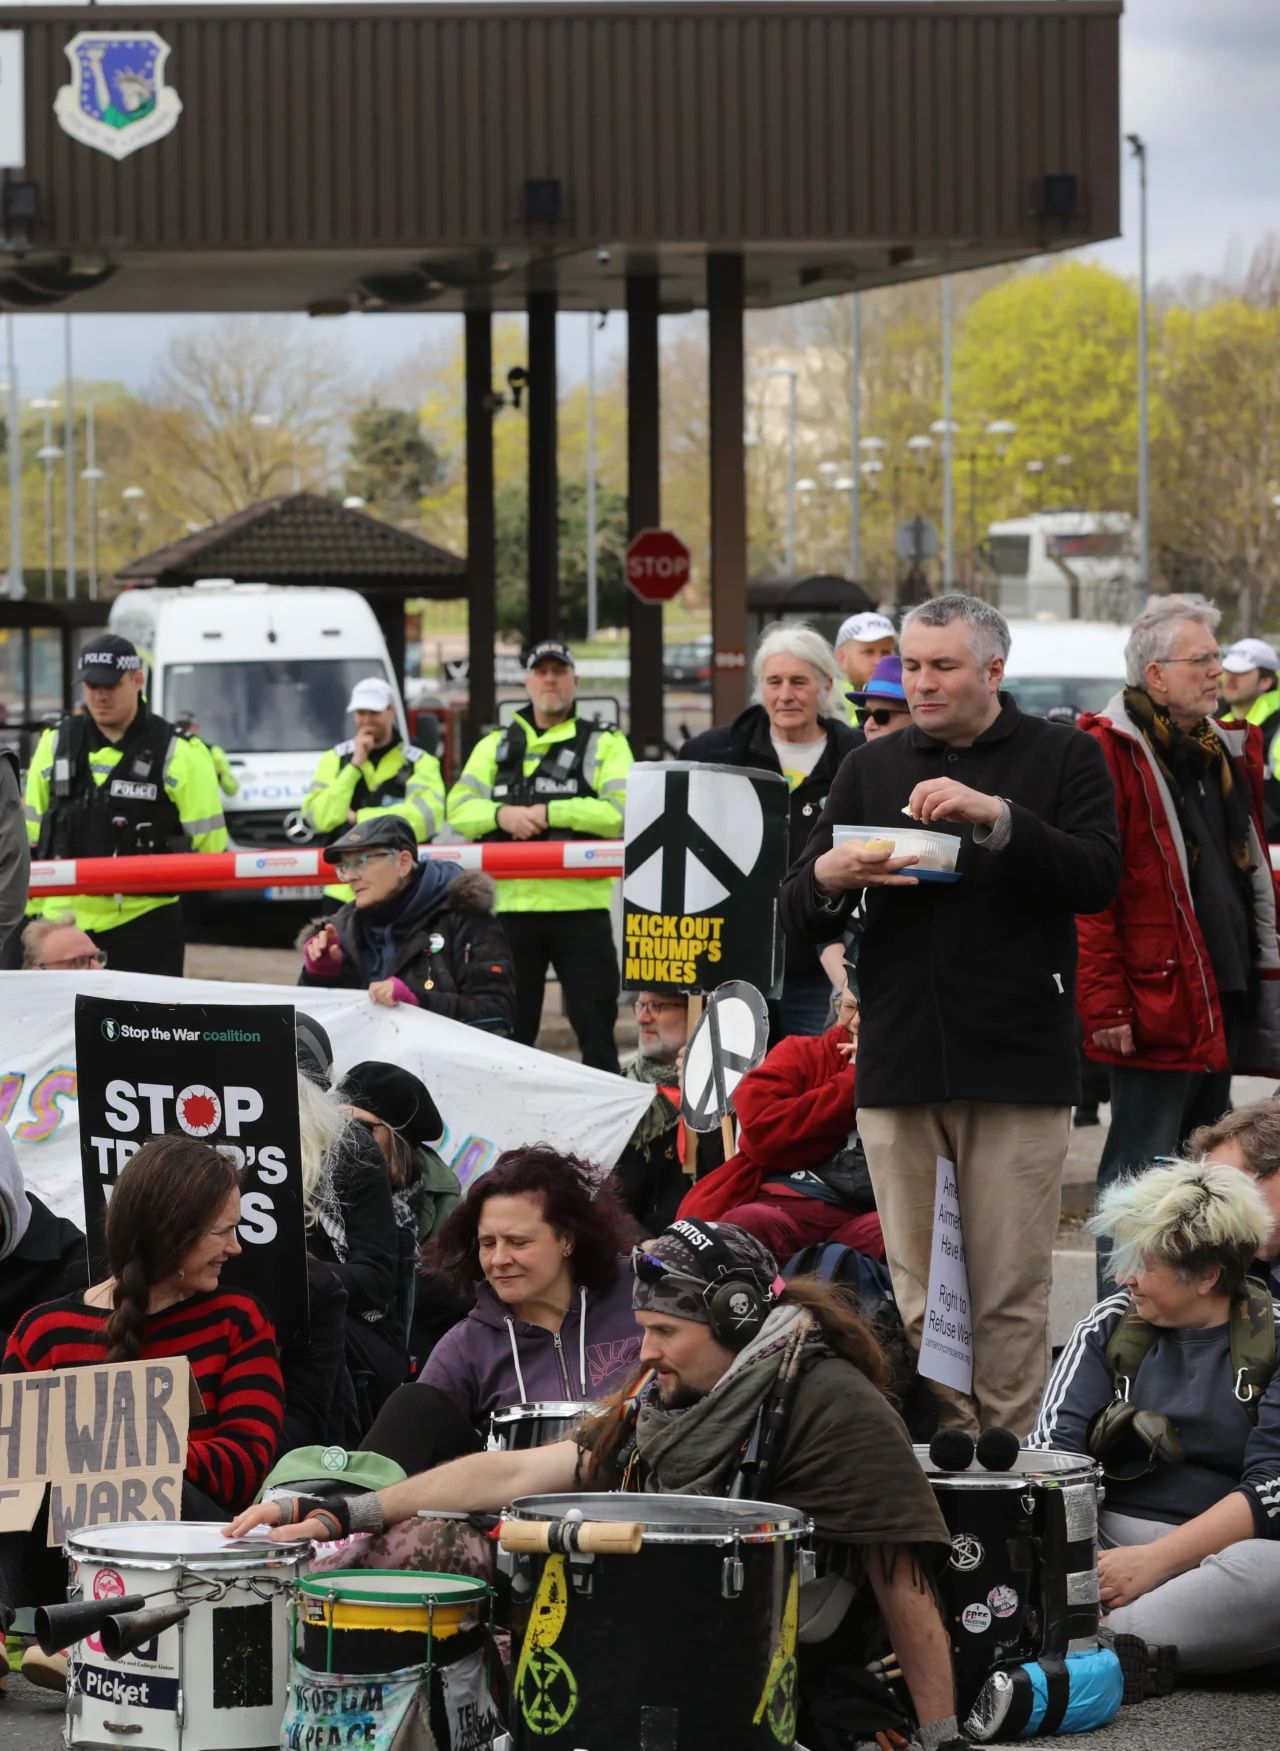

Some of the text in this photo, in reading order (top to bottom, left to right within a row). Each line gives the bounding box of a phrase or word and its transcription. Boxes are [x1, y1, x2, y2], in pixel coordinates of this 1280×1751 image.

[629, 556, 689, 578] STOP
[84, 652, 113, 664] POLICE
[113, 783, 154, 798] POLICE
[626, 914, 724, 940] KICK OUT
[625, 935, 722, 962] TRUMP'S
[625, 958, 697, 984] NUKES
[121, 1025, 261, 1043] Stop the War coalition
[105, 1079, 264, 1137] STOP
[941, 1233, 959, 1260] Have
[939, 1283, 967, 1315] Right to
[928, 1309, 972, 1346] Refuse War
[64, 1366, 181, 1474] WAR
[51, 1475, 177, 1545] WARS
[137, 1661, 157, 1670] College
[86, 1671, 150, 1704] Picket
[311, 1682, 384, 1716] DRUM
[305, 1723, 377, 1750] PEACE
